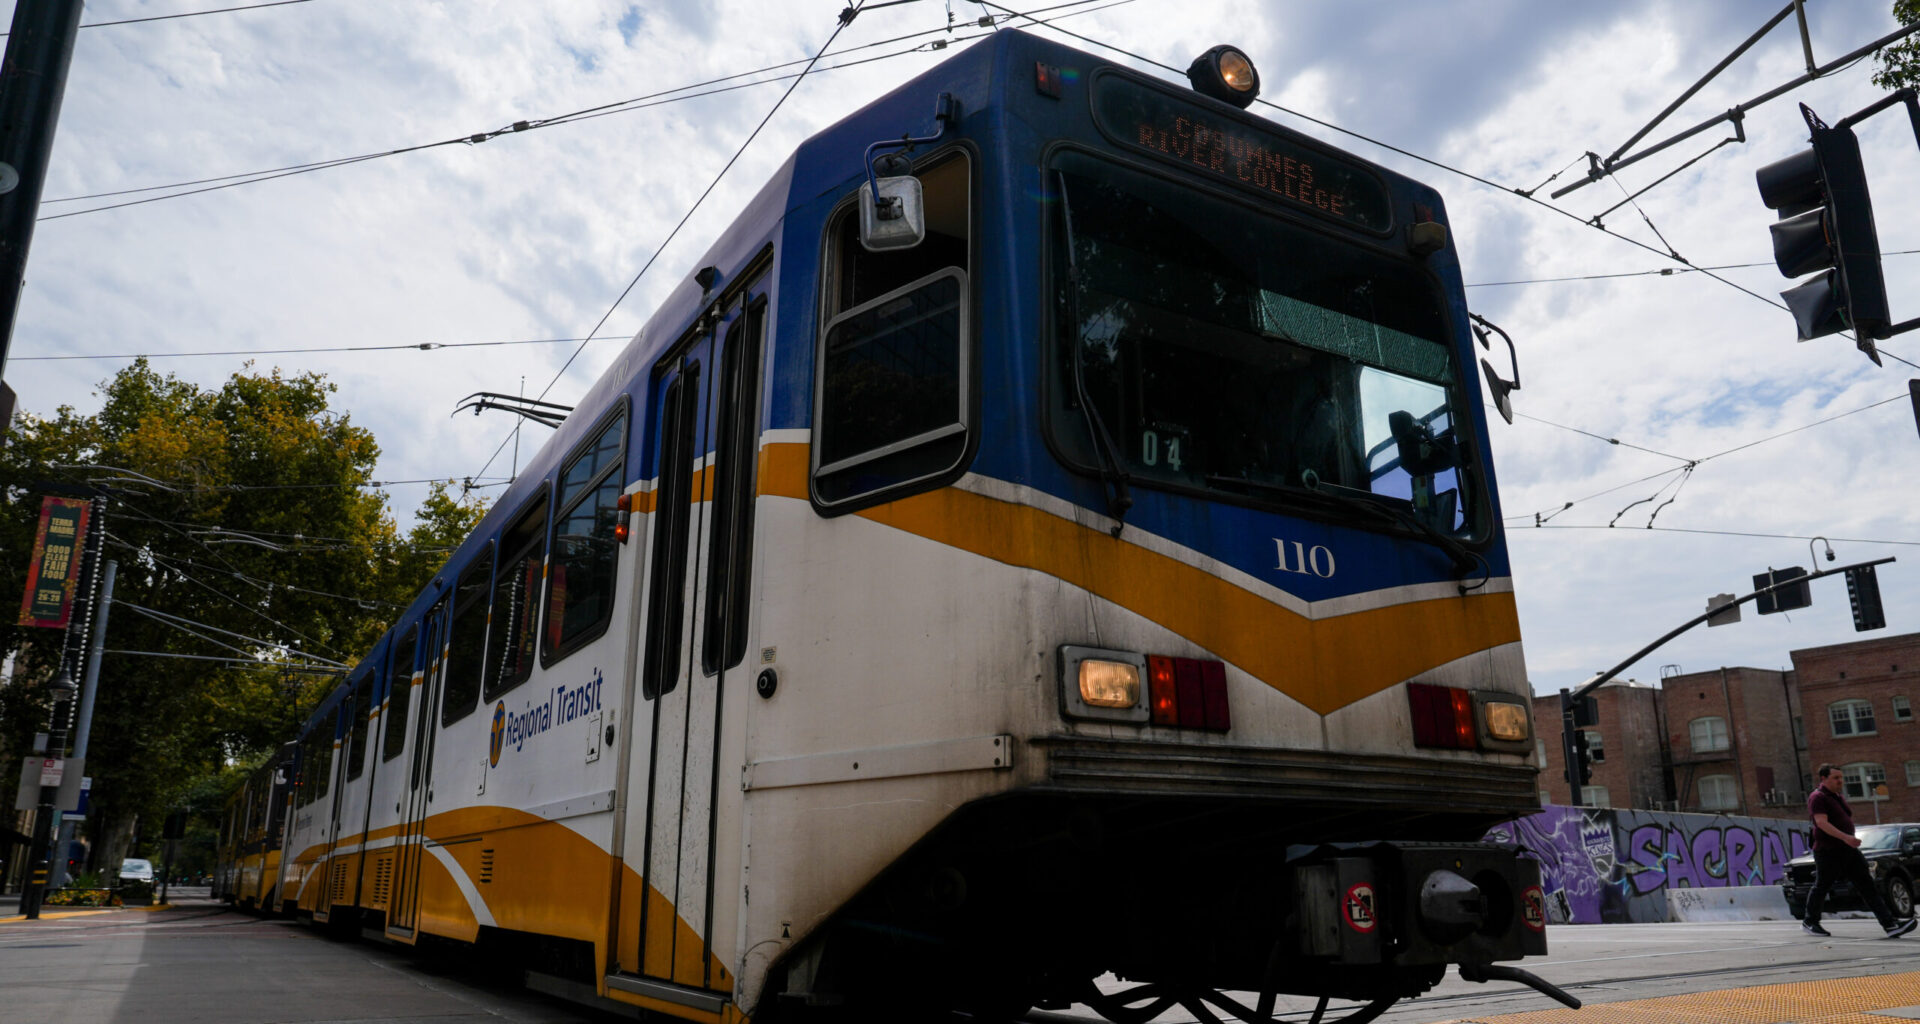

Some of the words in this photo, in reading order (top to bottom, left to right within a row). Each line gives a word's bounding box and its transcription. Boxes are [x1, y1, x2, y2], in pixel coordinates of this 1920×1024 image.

[1139, 124, 1225, 173] RIVER
[1236, 160, 1345, 216] COLLEGE
[1176, 116, 1313, 185] COSUMNES
[43, 561, 67, 571] FAIR
[47, 545, 70, 554] GOOD
[1271, 537, 1336, 579] 110
[42, 570, 65, 579] FOOD
[505, 687, 554, 753] Regional
[556, 667, 603, 727] Transit
